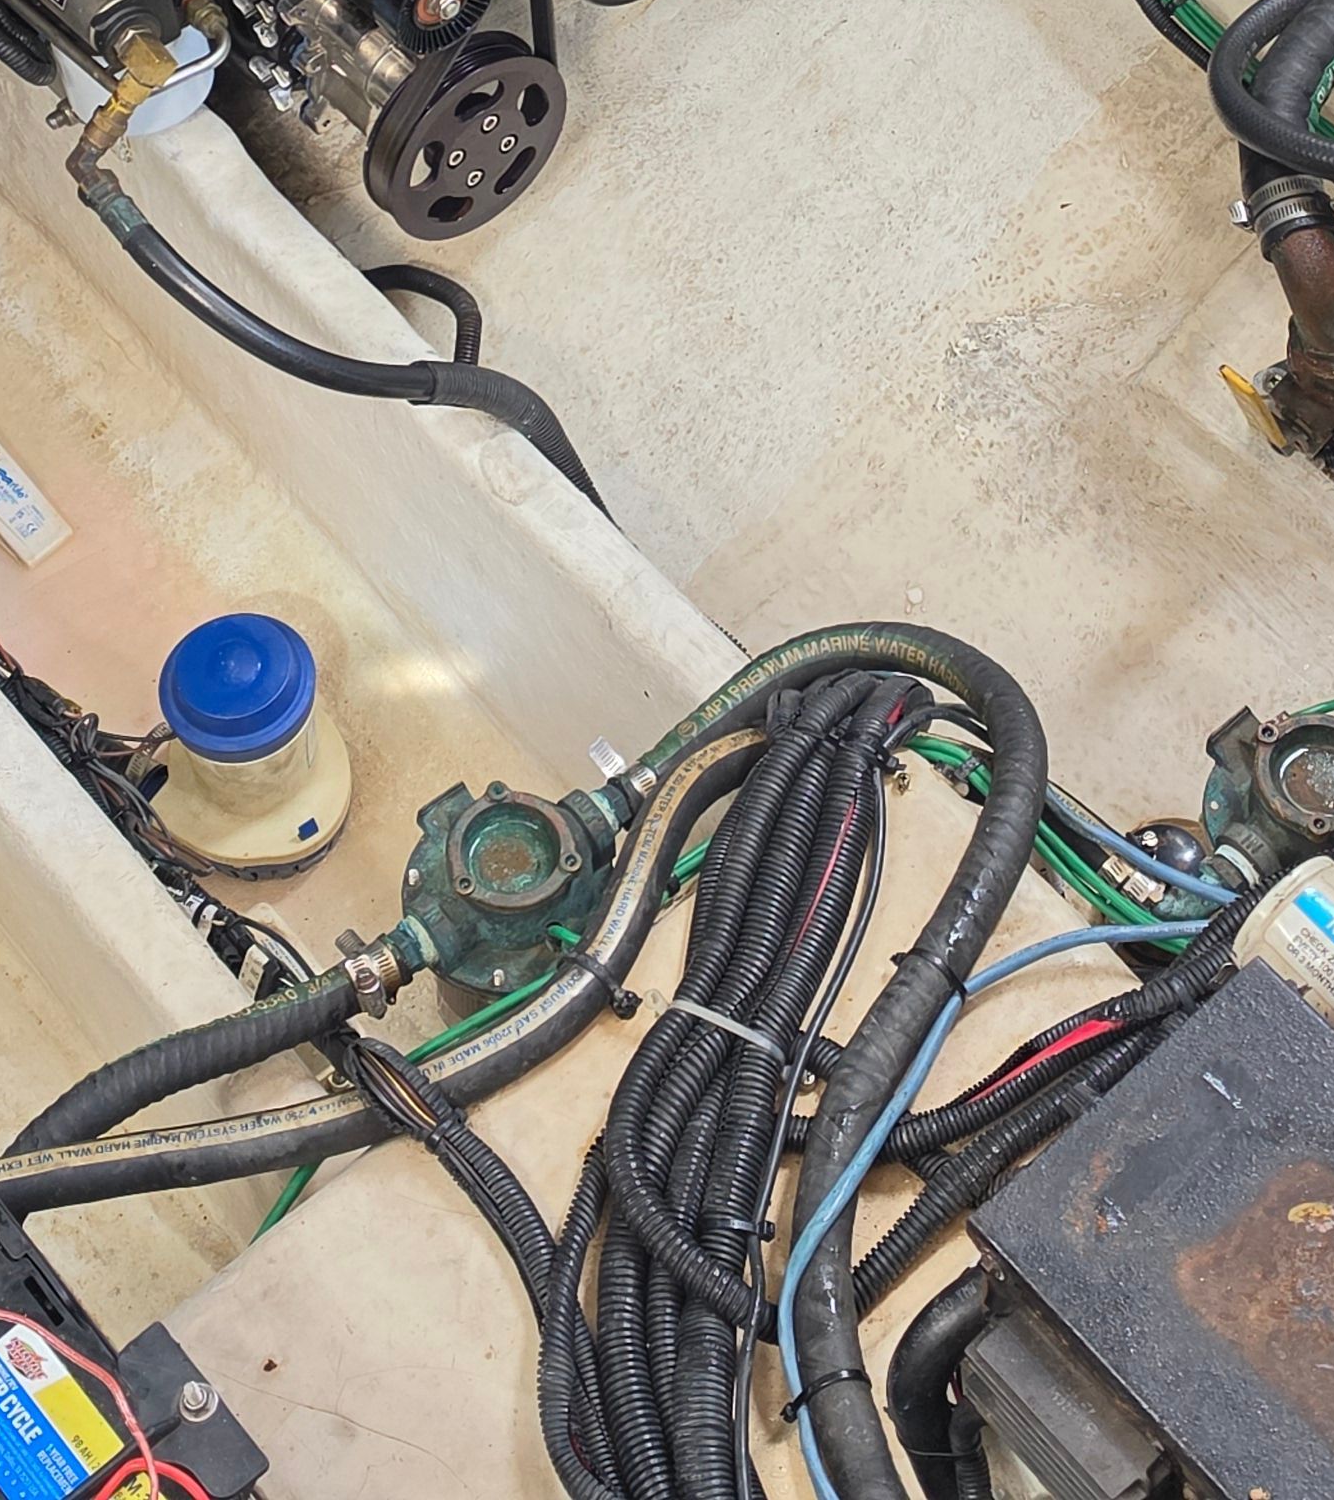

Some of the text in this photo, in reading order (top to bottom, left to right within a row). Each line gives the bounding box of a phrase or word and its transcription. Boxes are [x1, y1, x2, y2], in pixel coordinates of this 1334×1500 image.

[728, 650, 802, 701] PREMIUM
[803, 634, 870, 661] MARINE
[873, 636, 927, 668] WATER
[610, 885, 633, 919] HARD
[594, 916, 620, 949] WALL
[1293, 925, 1332, 960] CHECK
[1282, 941, 1300, 959] OR
[511, 1007, 541, 1030] SAE
[445, 1039, 482, 1067] MADE
[429, 1057, 446, 1075] IN
[237, 1111, 281, 1133] WATER
[55, 1144, 91, 1163] WALL
[93, 1138, 130, 1157] HARD
[23, 1151, 53, 1168] WET
[59, 1465, 79, 1487] FREE
